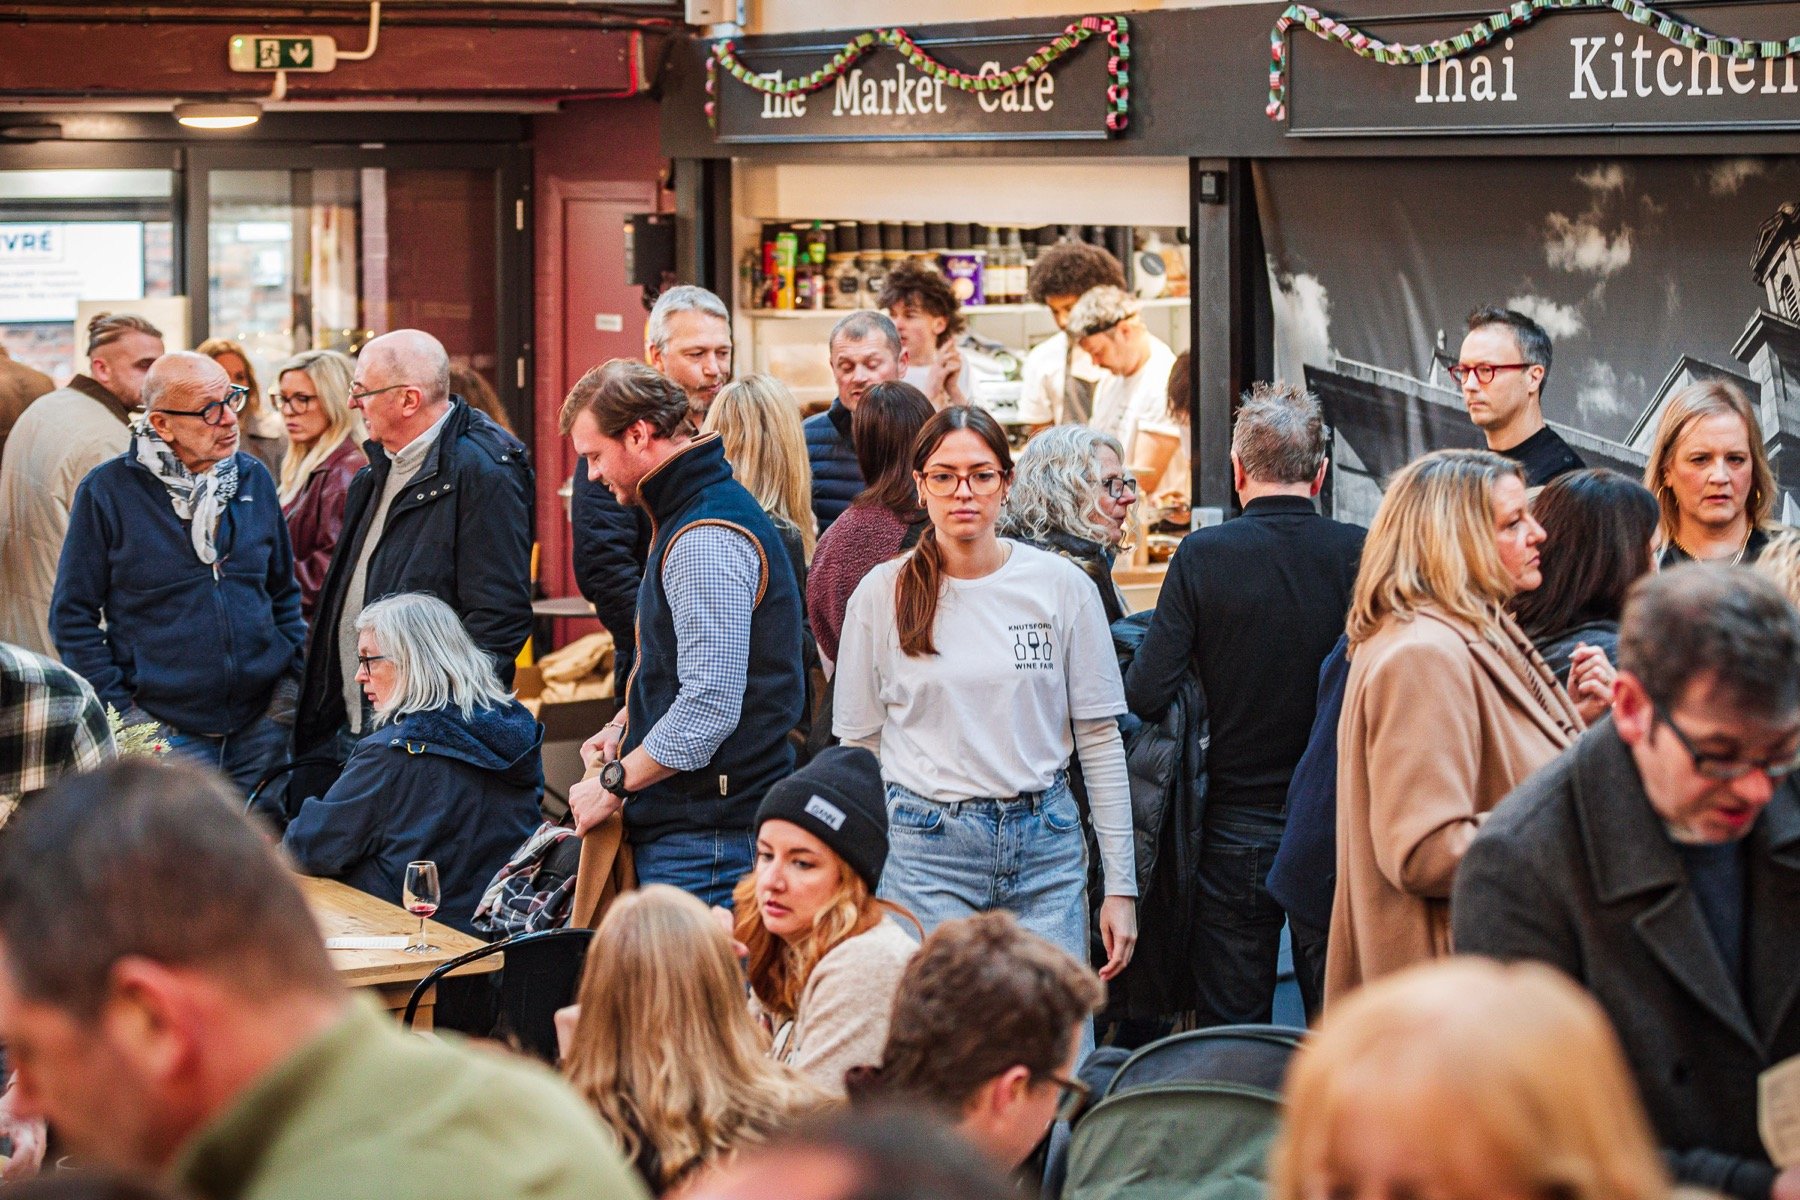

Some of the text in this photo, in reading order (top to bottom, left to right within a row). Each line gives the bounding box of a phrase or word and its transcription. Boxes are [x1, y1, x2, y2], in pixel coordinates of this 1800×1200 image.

[1569, 32, 1799, 100] Kitchen
[832, 63, 947, 117] Market
[1008, 623, 1052, 631] KNUTSFORD
[1014, 662, 1054, 670] WINE FAIR
